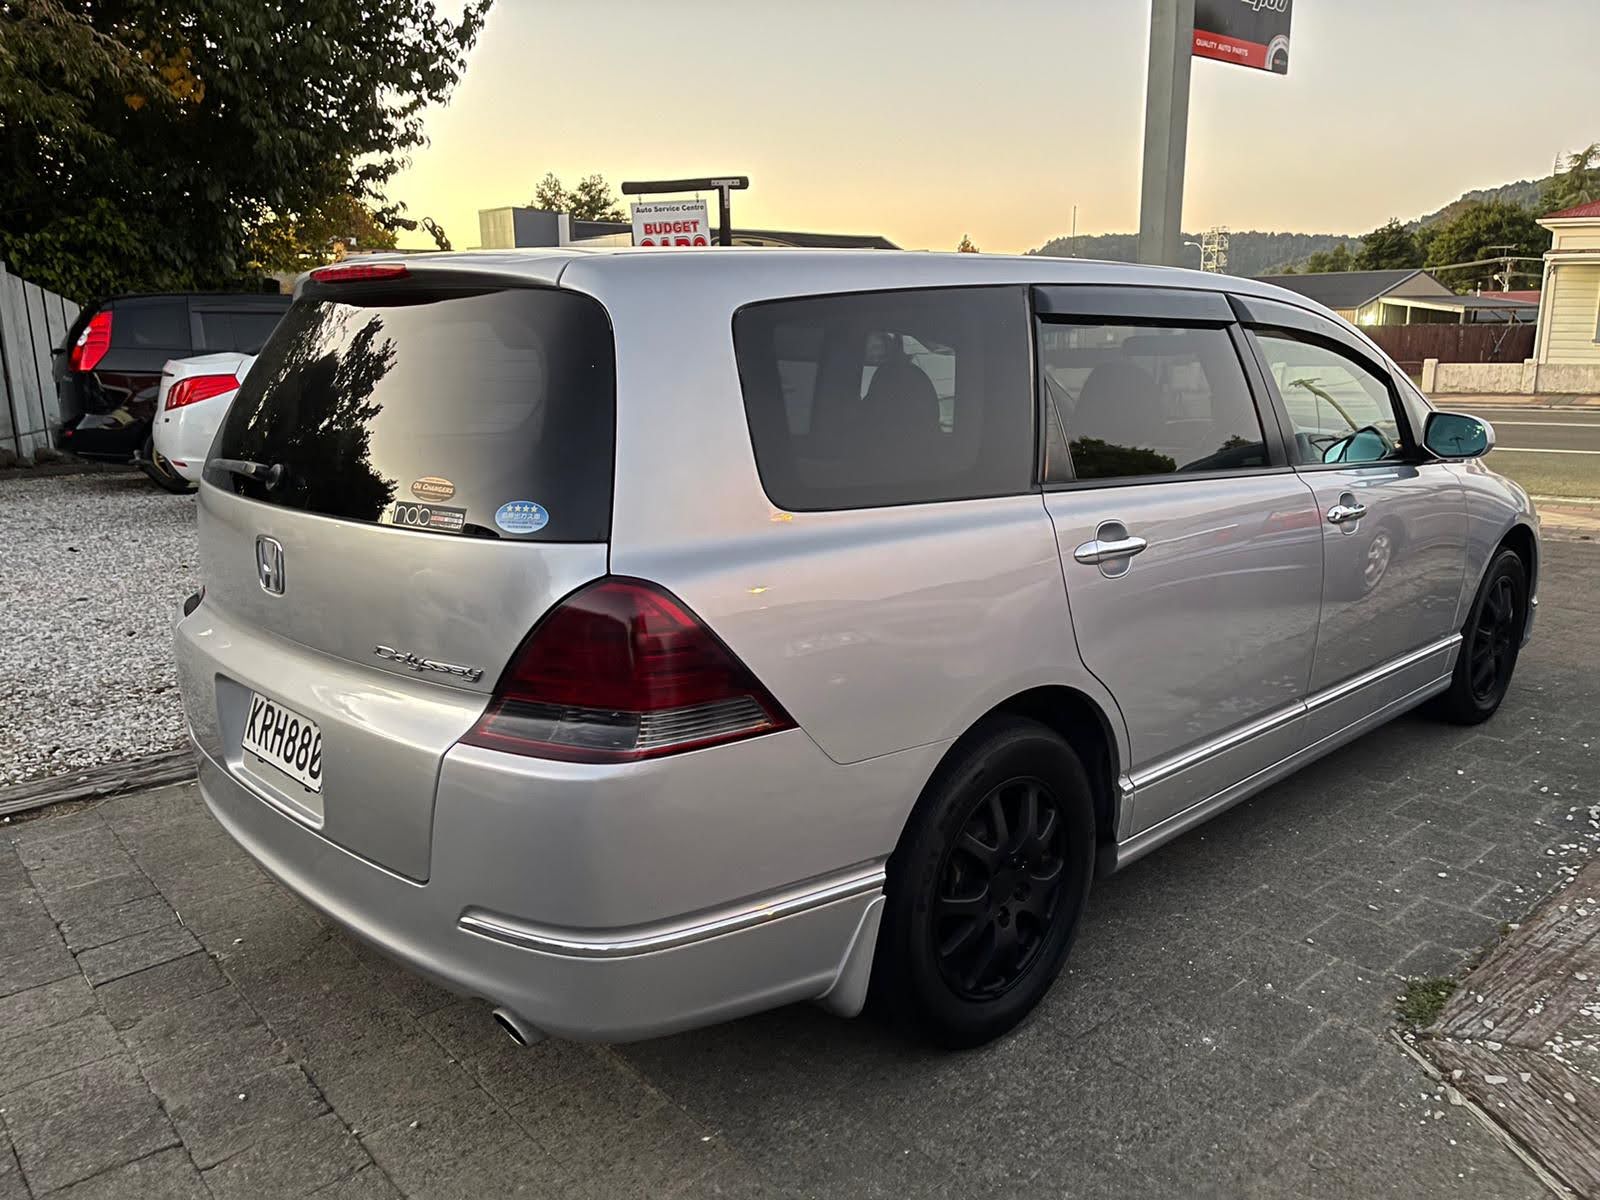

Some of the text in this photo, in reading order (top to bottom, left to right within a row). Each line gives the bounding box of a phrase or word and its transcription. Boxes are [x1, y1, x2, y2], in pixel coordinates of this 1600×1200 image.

[1196, 38, 1248, 57] QUALITY AUTO PARTS
[654, 205, 680, 213] Service
[643, 219, 700, 235] BUDGET
[374, 644, 484, 683] Odyssey
